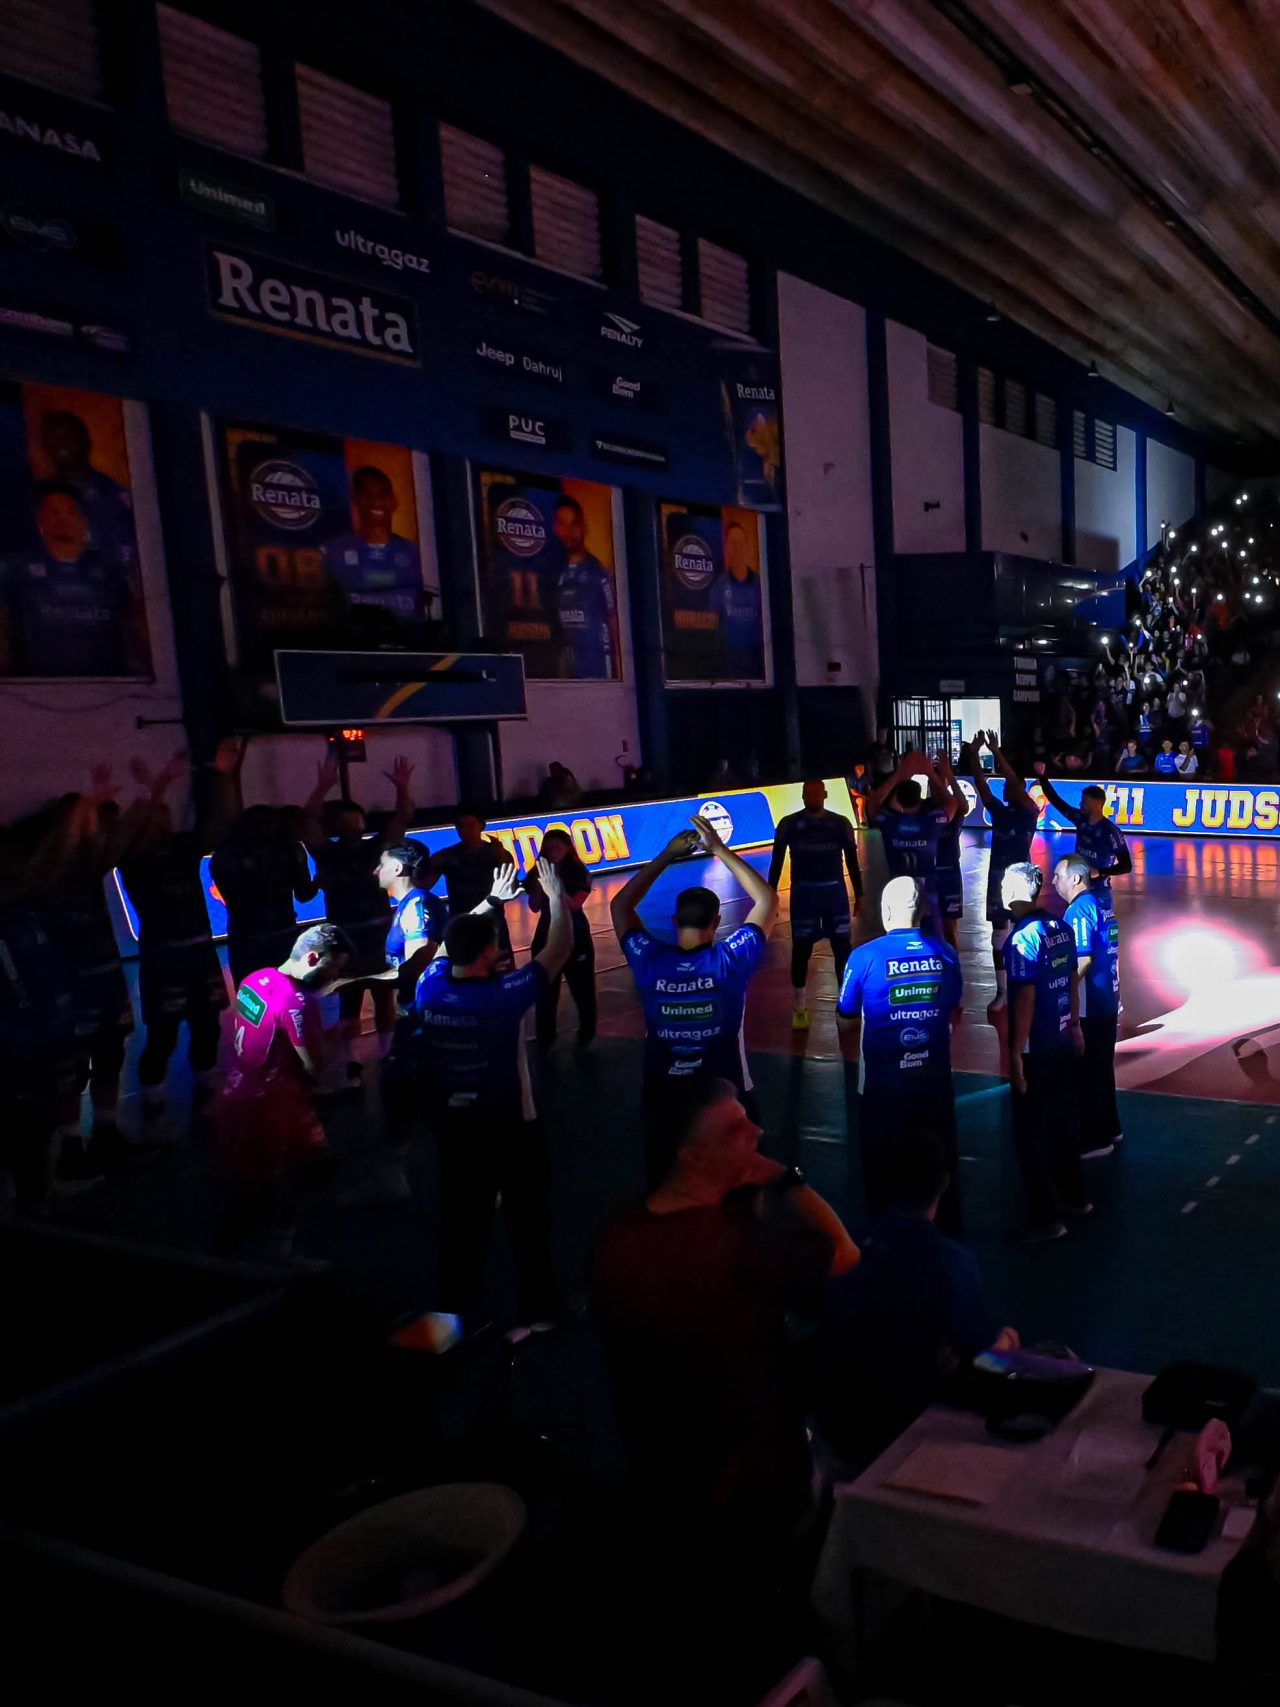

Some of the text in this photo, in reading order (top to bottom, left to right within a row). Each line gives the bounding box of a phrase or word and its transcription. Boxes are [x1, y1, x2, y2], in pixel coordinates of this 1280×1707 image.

[333, 227, 432, 273] ultragaz
[212, 249, 414, 354] Renata
[600, 324, 645, 350] PENALTY
[475, 341, 564, 384] Jeep Dahruj
[735, 382, 776, 401] Renata
[508, 413, 546, 437] PUC
[251, 484, 321, 511] Renata
[496, 516, 547, 539] Renata
[674, 554, 714, 573] Renata
[888, 957, 944, 977] Renata
[655, 976, 725, 994] Renata
[895, 985, 938, 998] Unimed
[660, 1003, 714, 1016] Unimed
[889, 1008, 940, 1021] ultragaz
[656, 1025, 721, 1041] ultragaz
[903, 1050, 929, 1061] Good
